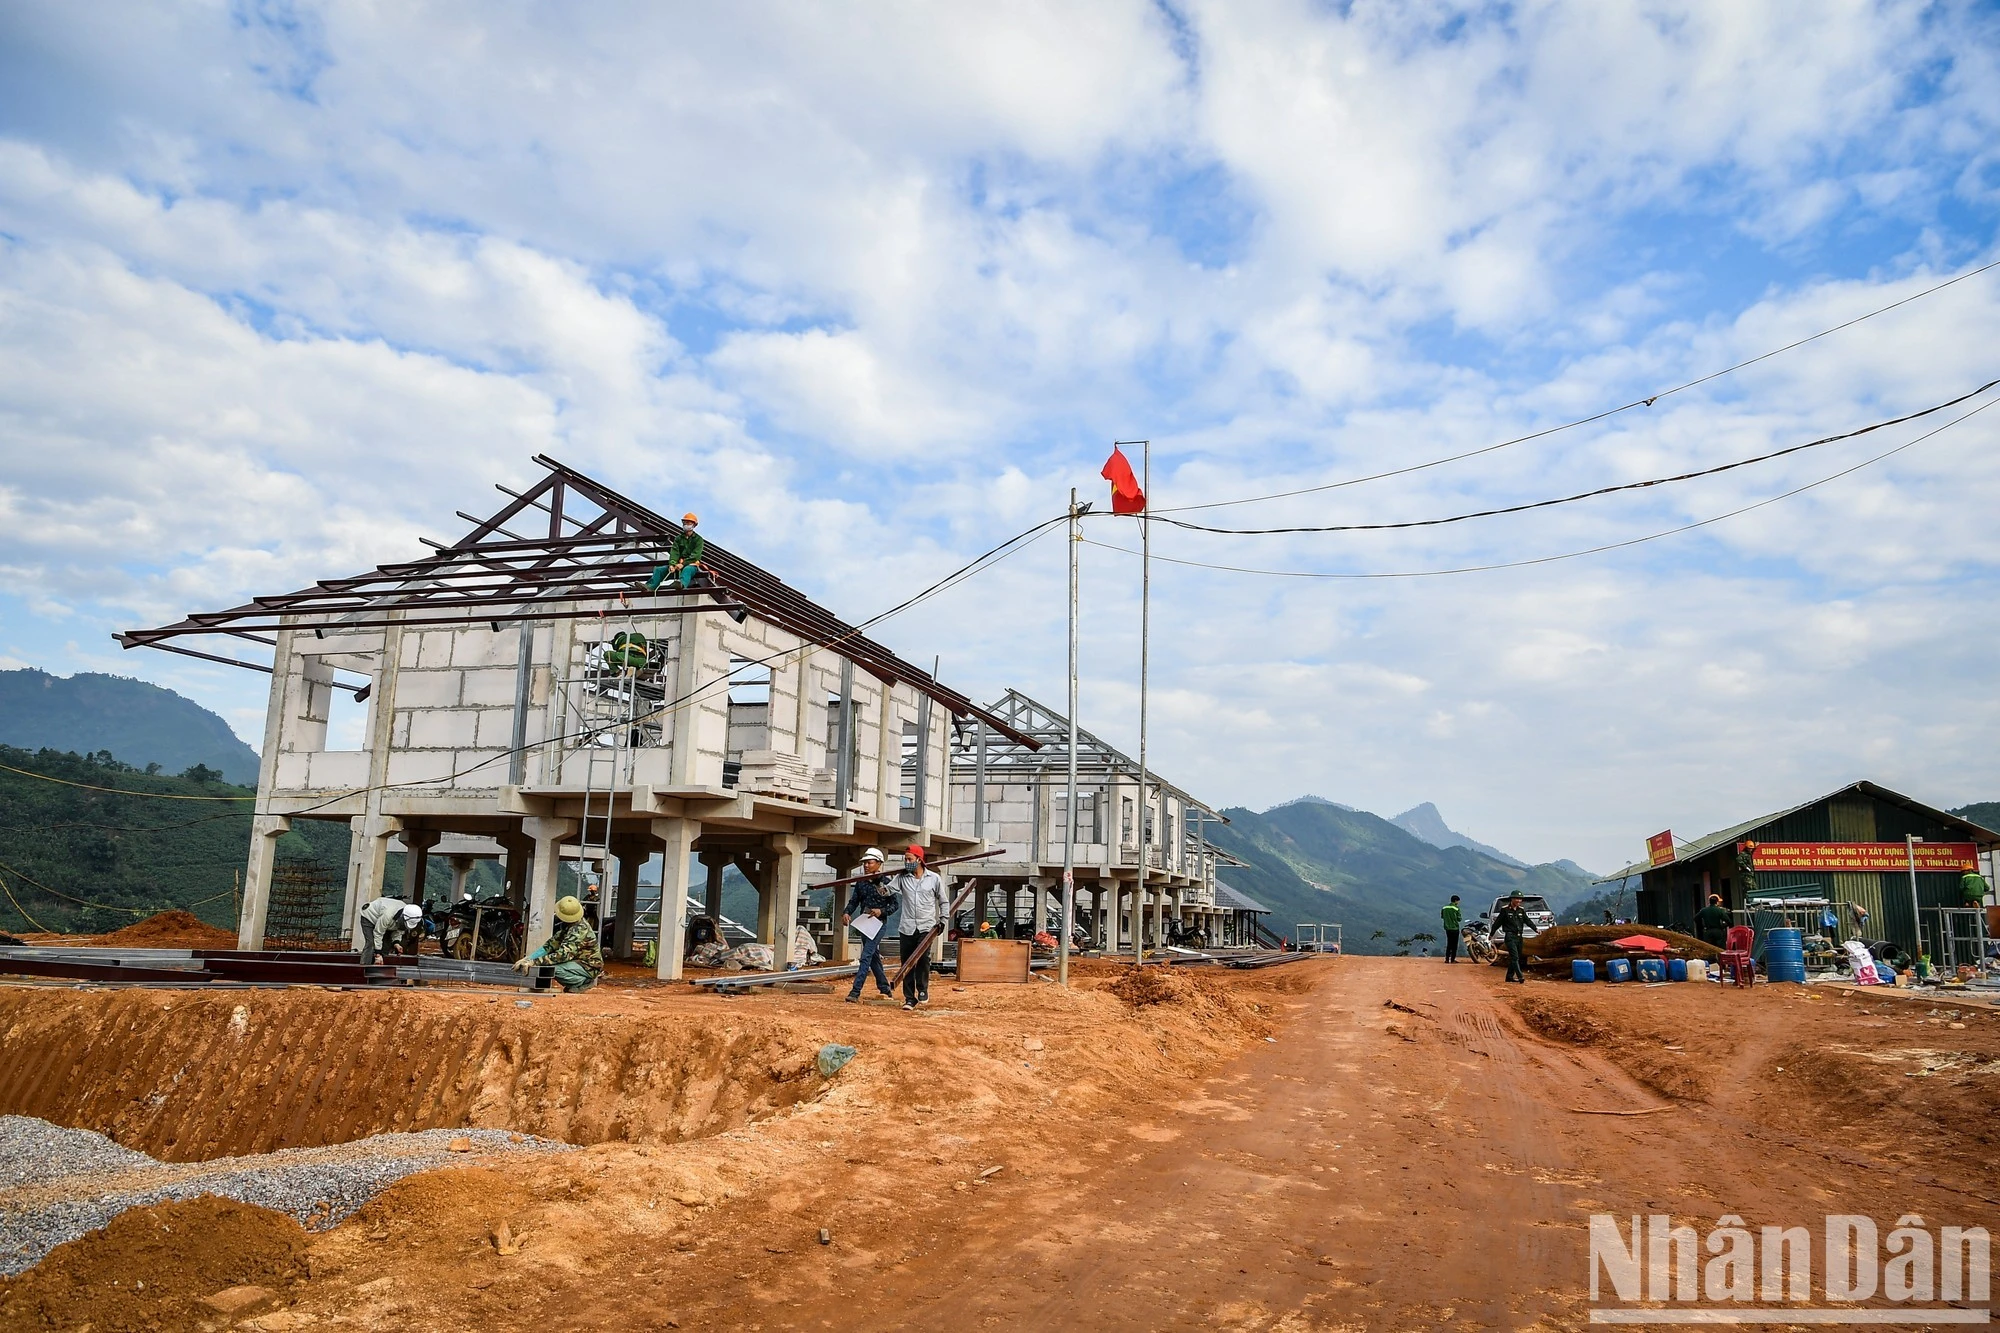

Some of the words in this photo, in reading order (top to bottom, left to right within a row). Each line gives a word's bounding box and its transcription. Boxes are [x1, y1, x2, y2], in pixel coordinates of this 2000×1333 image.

[1761, 847, 1779, 855] BINH
[1780, 846, 1800, 855] ĐOÀN
[1801, 847, 1811, 855] 12
[1816, 845, 1836, 855] TỔNG
[1836, 846, 1857, 855] CÔNG
[1868, 846, 1883, 855] XÂY
[1884, 847, 1905, 857] DỰNG
[1936, 847, 1953, 856] SƠN
[1765, 858, 1778, 866] GIA
[1779, 858, 1790, 866] THI
[1791, 857, 1812, 866] CÔNG
[1825, 856, 1845, 866] THIẾT
[1846, 857, 1862, 866] NHÀ
[1863, 856, 1869, 866] Ở
[1870, 857, 1889, 867] THÔN
[1890, 857, 1910, 867] LÀNG
[1944, 857, 1959, 867] LÀO
